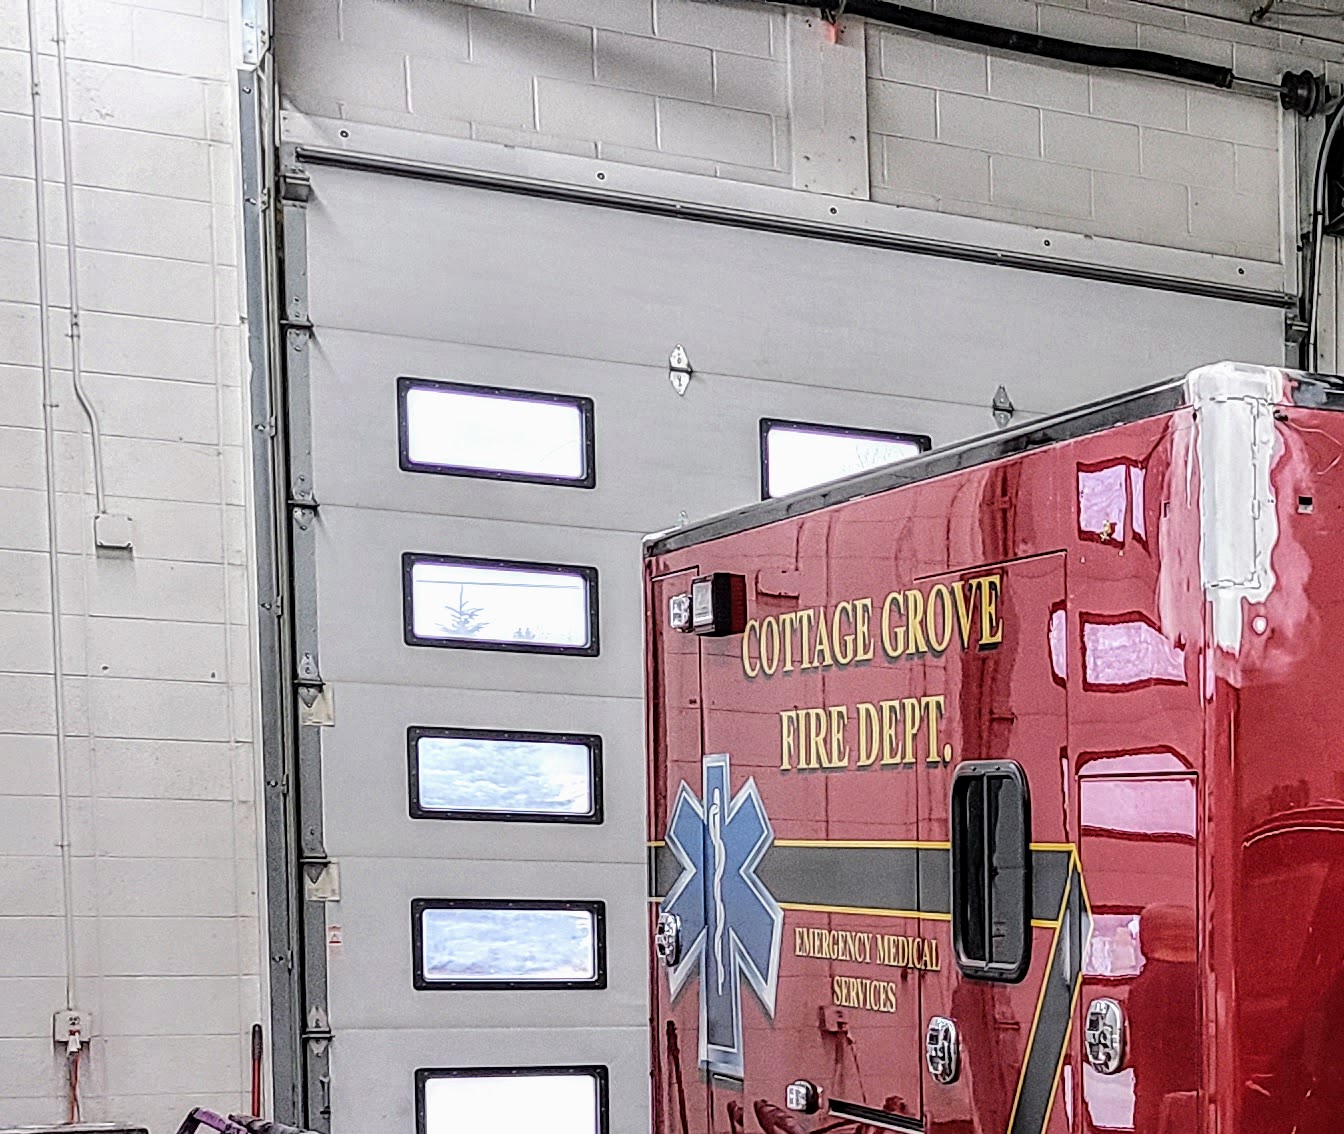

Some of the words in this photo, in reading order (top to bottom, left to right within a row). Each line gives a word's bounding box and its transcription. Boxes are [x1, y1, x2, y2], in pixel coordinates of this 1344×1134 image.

[742, 598, 874, 680] COTTAGE
[880, 575, 1003, 660] GROVE
[779, 705, 849, 771] FIRE
[856, 695, 952, 768] DEPT.
[795, 927, 872, 963] EMERGENCY
[876, 934, 941, 971] MEDICAL
[833, 976, 897, 1013] SERVICES
